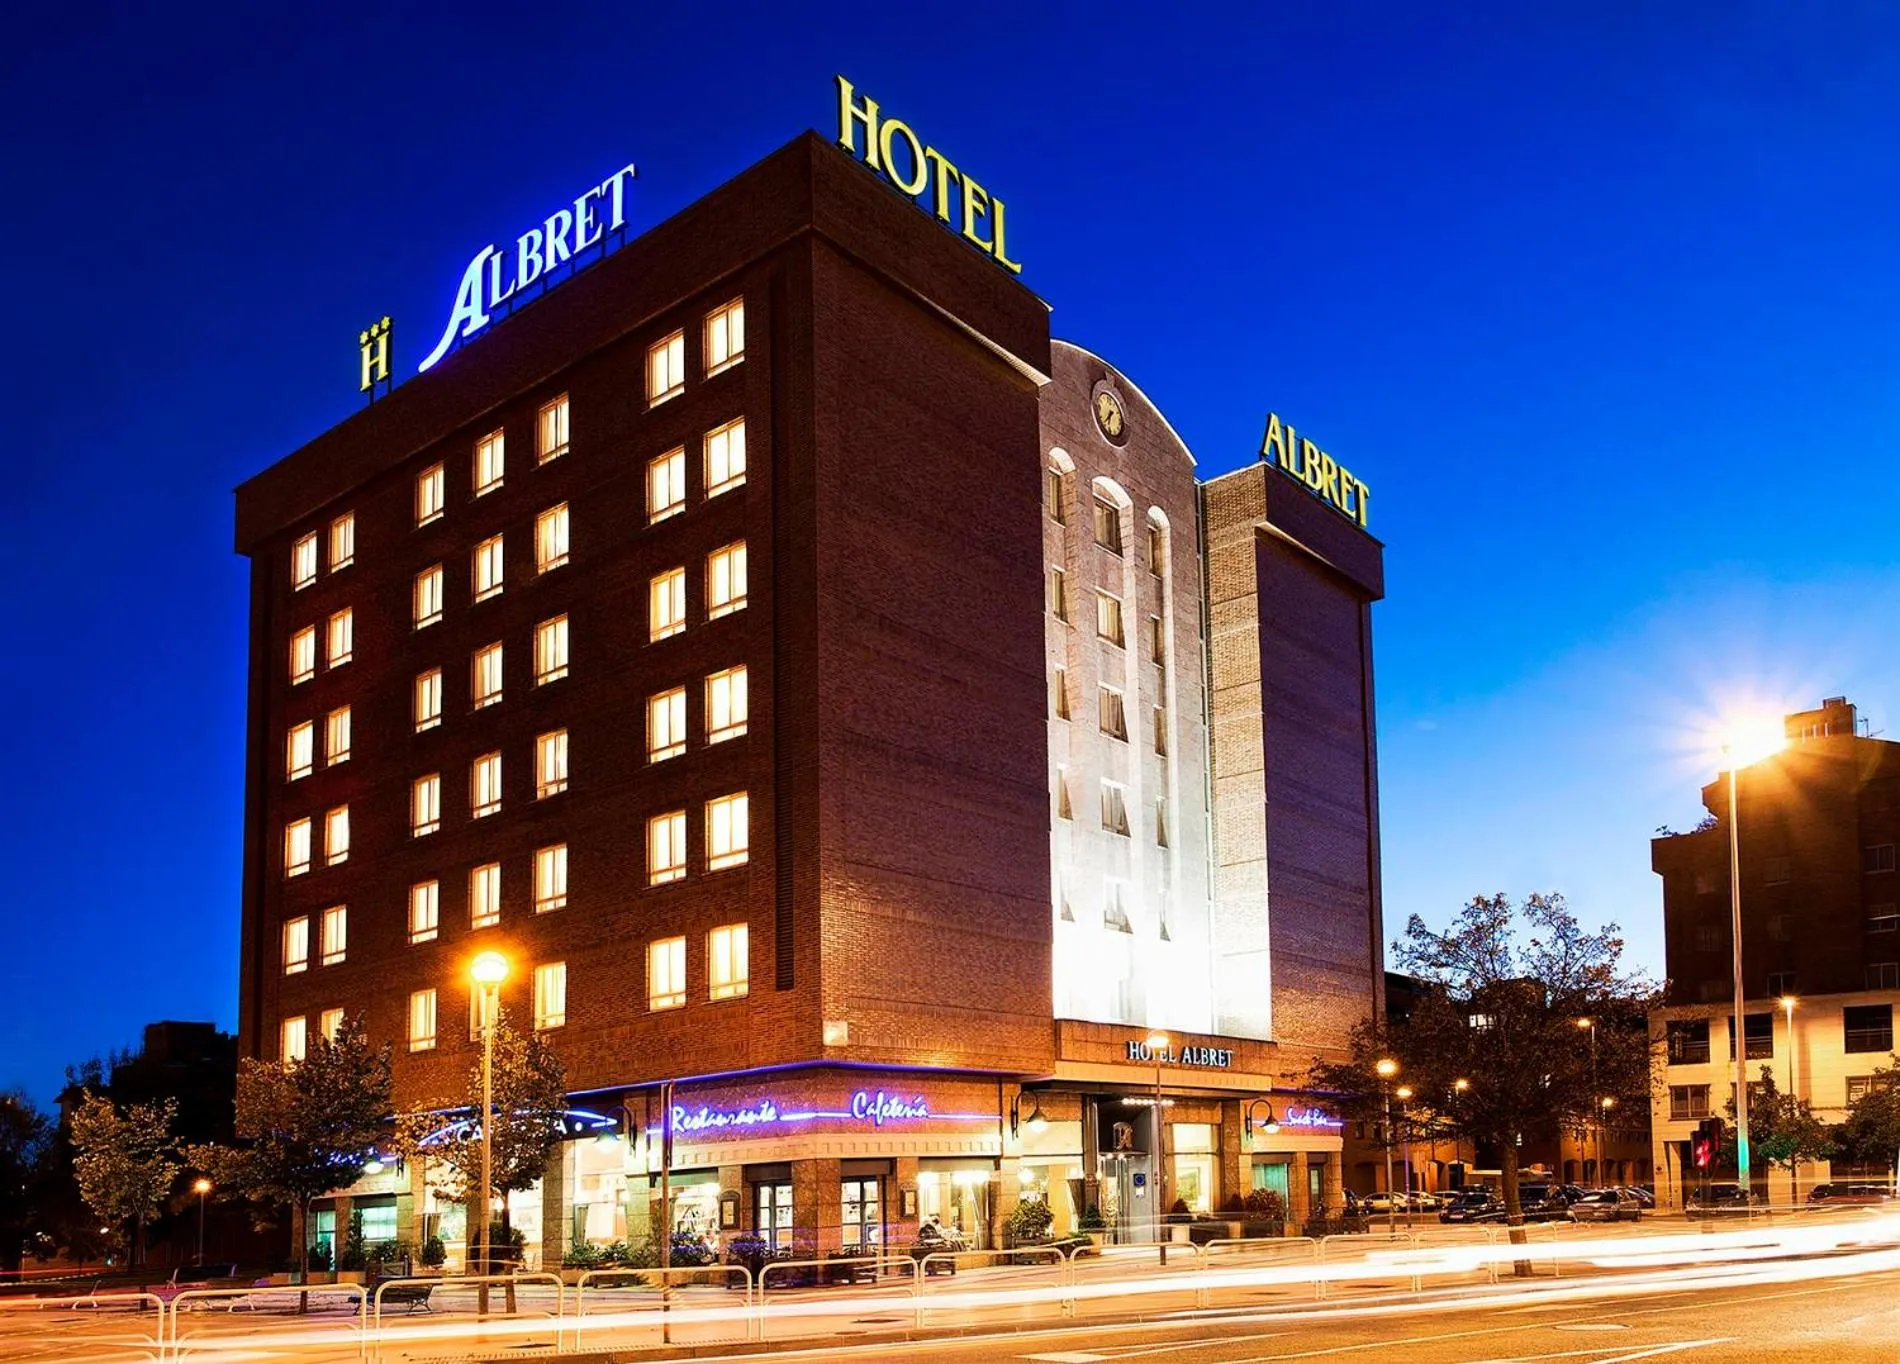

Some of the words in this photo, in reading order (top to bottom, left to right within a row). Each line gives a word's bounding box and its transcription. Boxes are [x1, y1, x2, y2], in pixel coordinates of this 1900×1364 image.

[836, 74, 1022, 274] HOTEL
[418, 163, 636, 373] ALBRET
[1263, 411, 1370, 528] ALBRET
[1182, 1046, 1233, 1067] ALBRET
[671, 1100, 778, 1132] Restaurante
